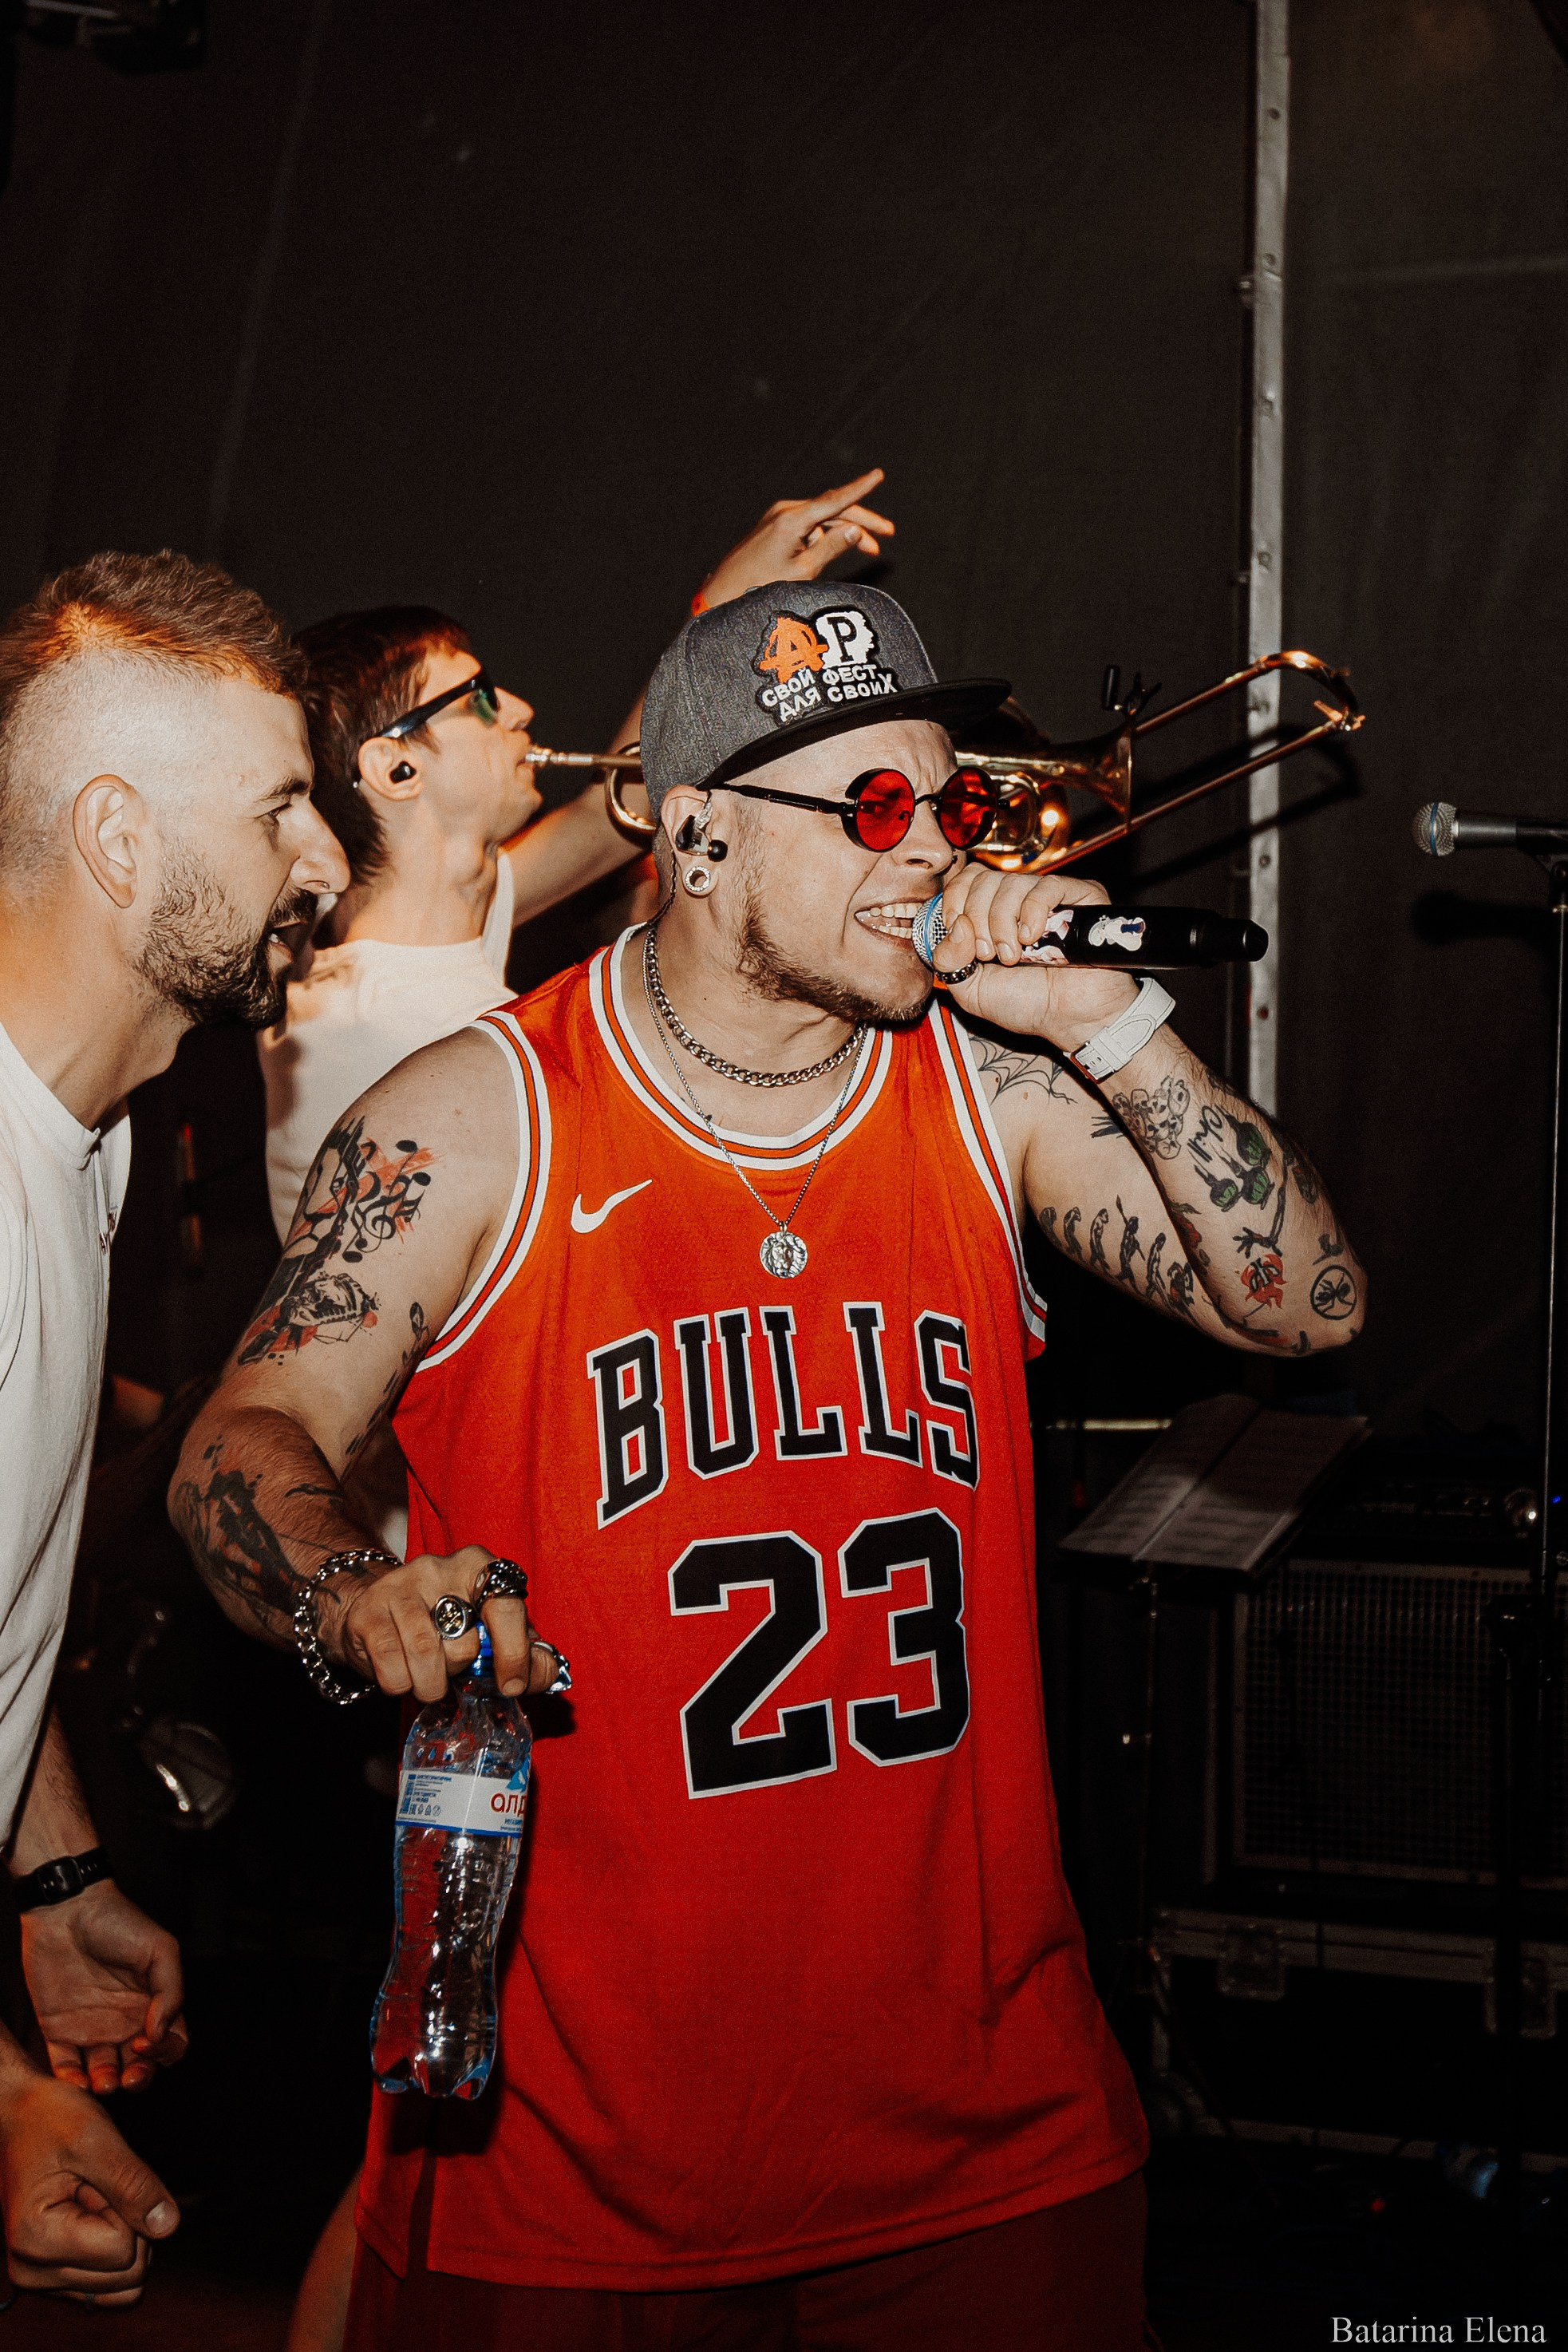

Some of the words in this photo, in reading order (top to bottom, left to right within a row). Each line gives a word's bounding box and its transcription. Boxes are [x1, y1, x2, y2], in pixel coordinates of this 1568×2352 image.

[761, 667, 816, 707] СВОЙ
[822, 664, 877, 686] ФЕСТ
[779, 687, 822, 722] ДЛЯ
[827, 673, 898, 702] СВОИХ
[587, 1301, 980, 1531] BULLS
[667, 1507, 970, 1800] 23
